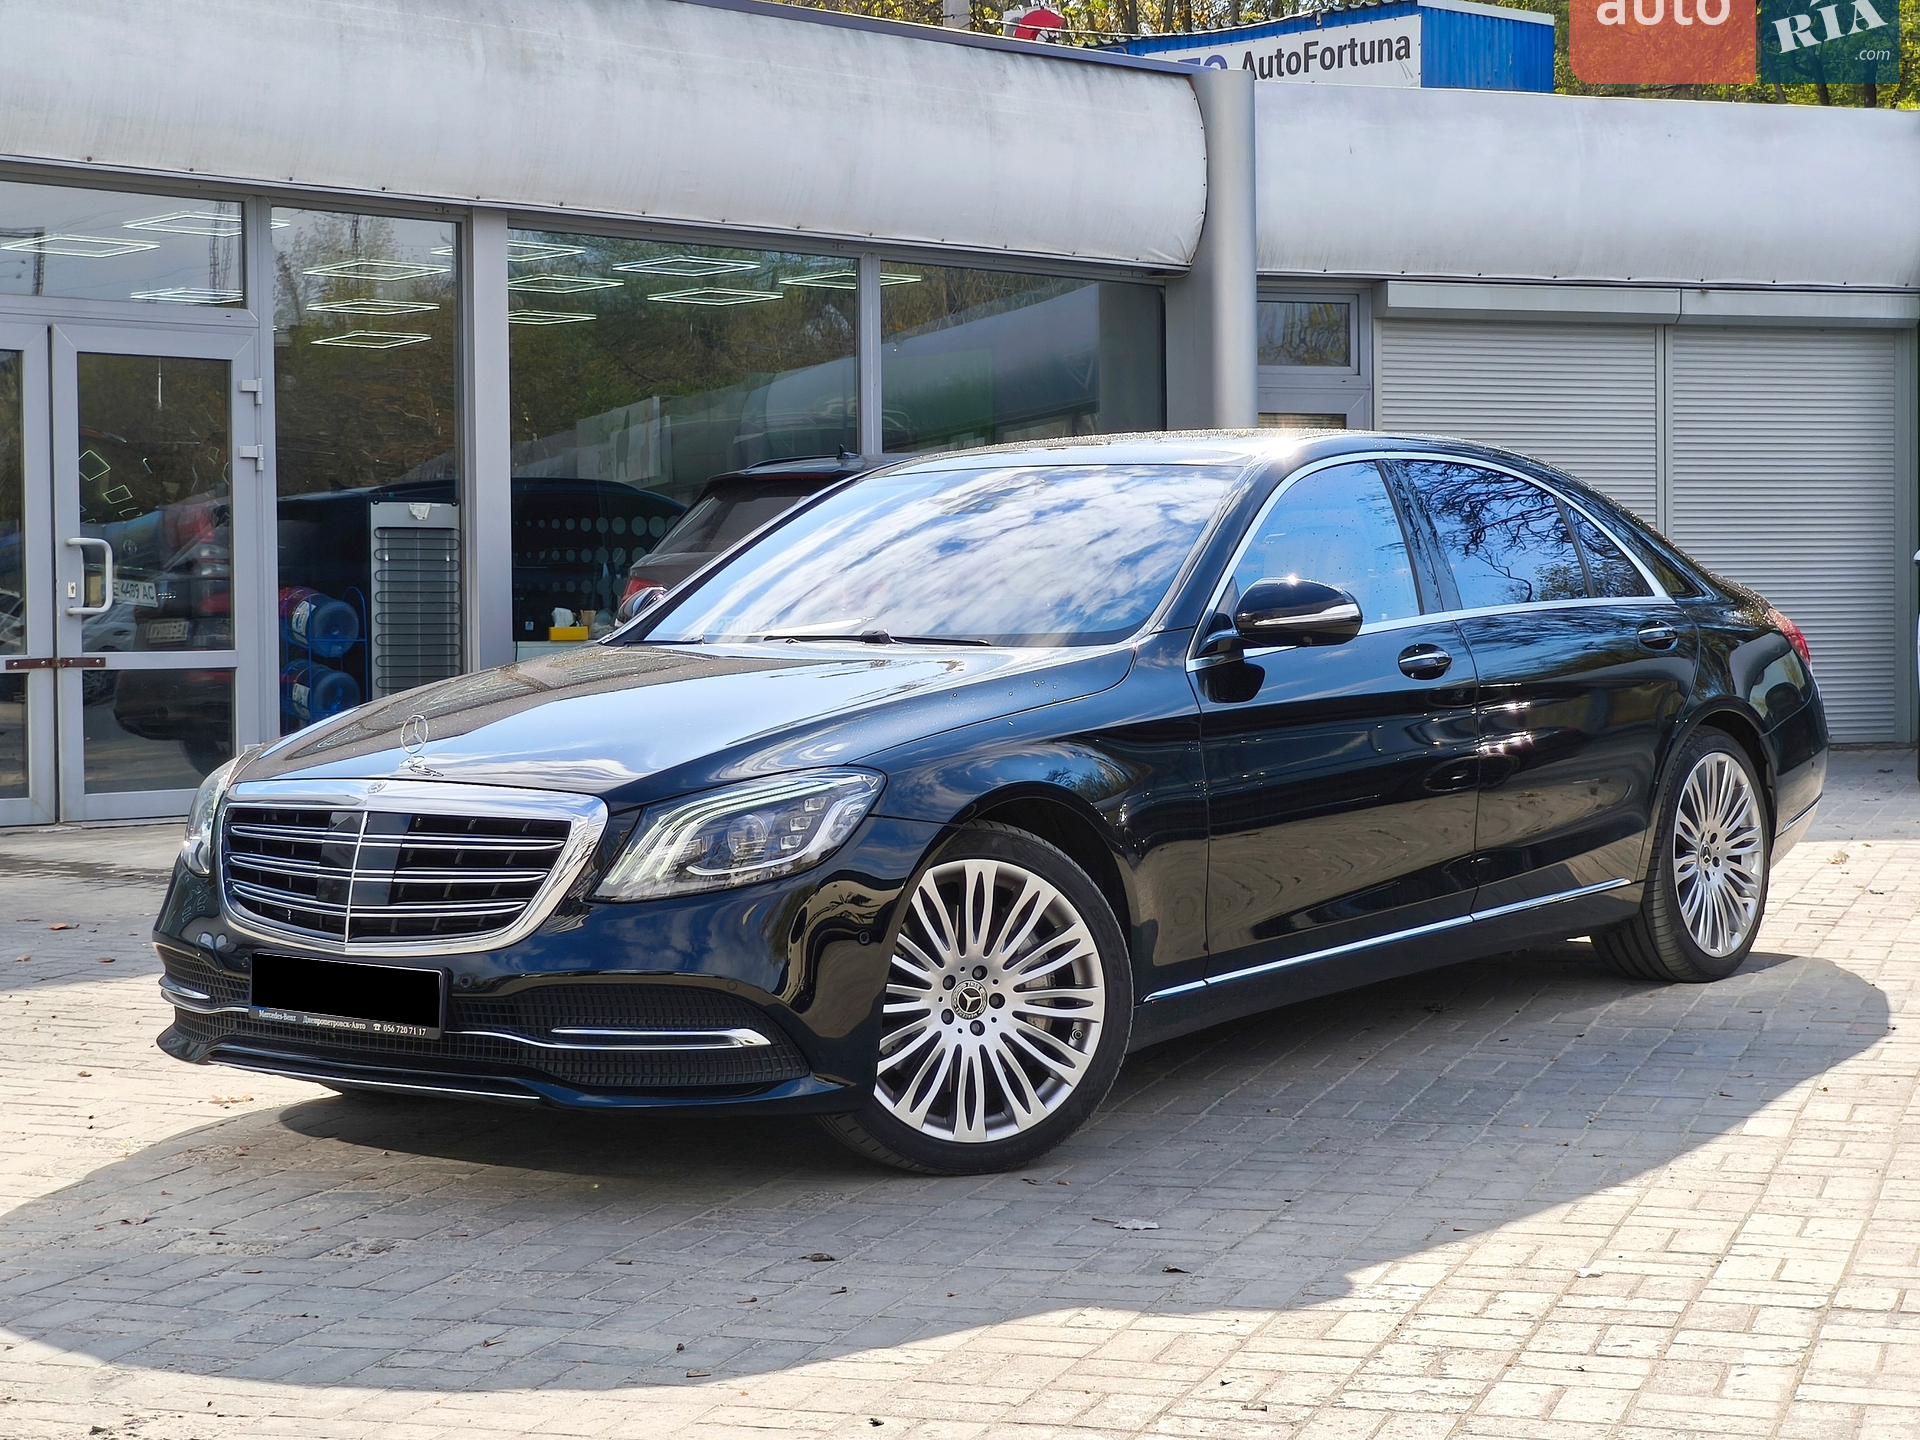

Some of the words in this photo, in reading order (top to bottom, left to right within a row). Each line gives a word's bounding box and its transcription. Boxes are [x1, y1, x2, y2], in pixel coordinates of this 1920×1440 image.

[1242, 35, 1411, 80] AutoFortuna
[258, 1009, 297, 1022] Mercedes-Benz
[383, 1025, 395, 1033] 056
[396, 1026, 407, 1035] 720
[408, 1027, 416, 1036] 71
[418, 1029, 427, 1037] 17
